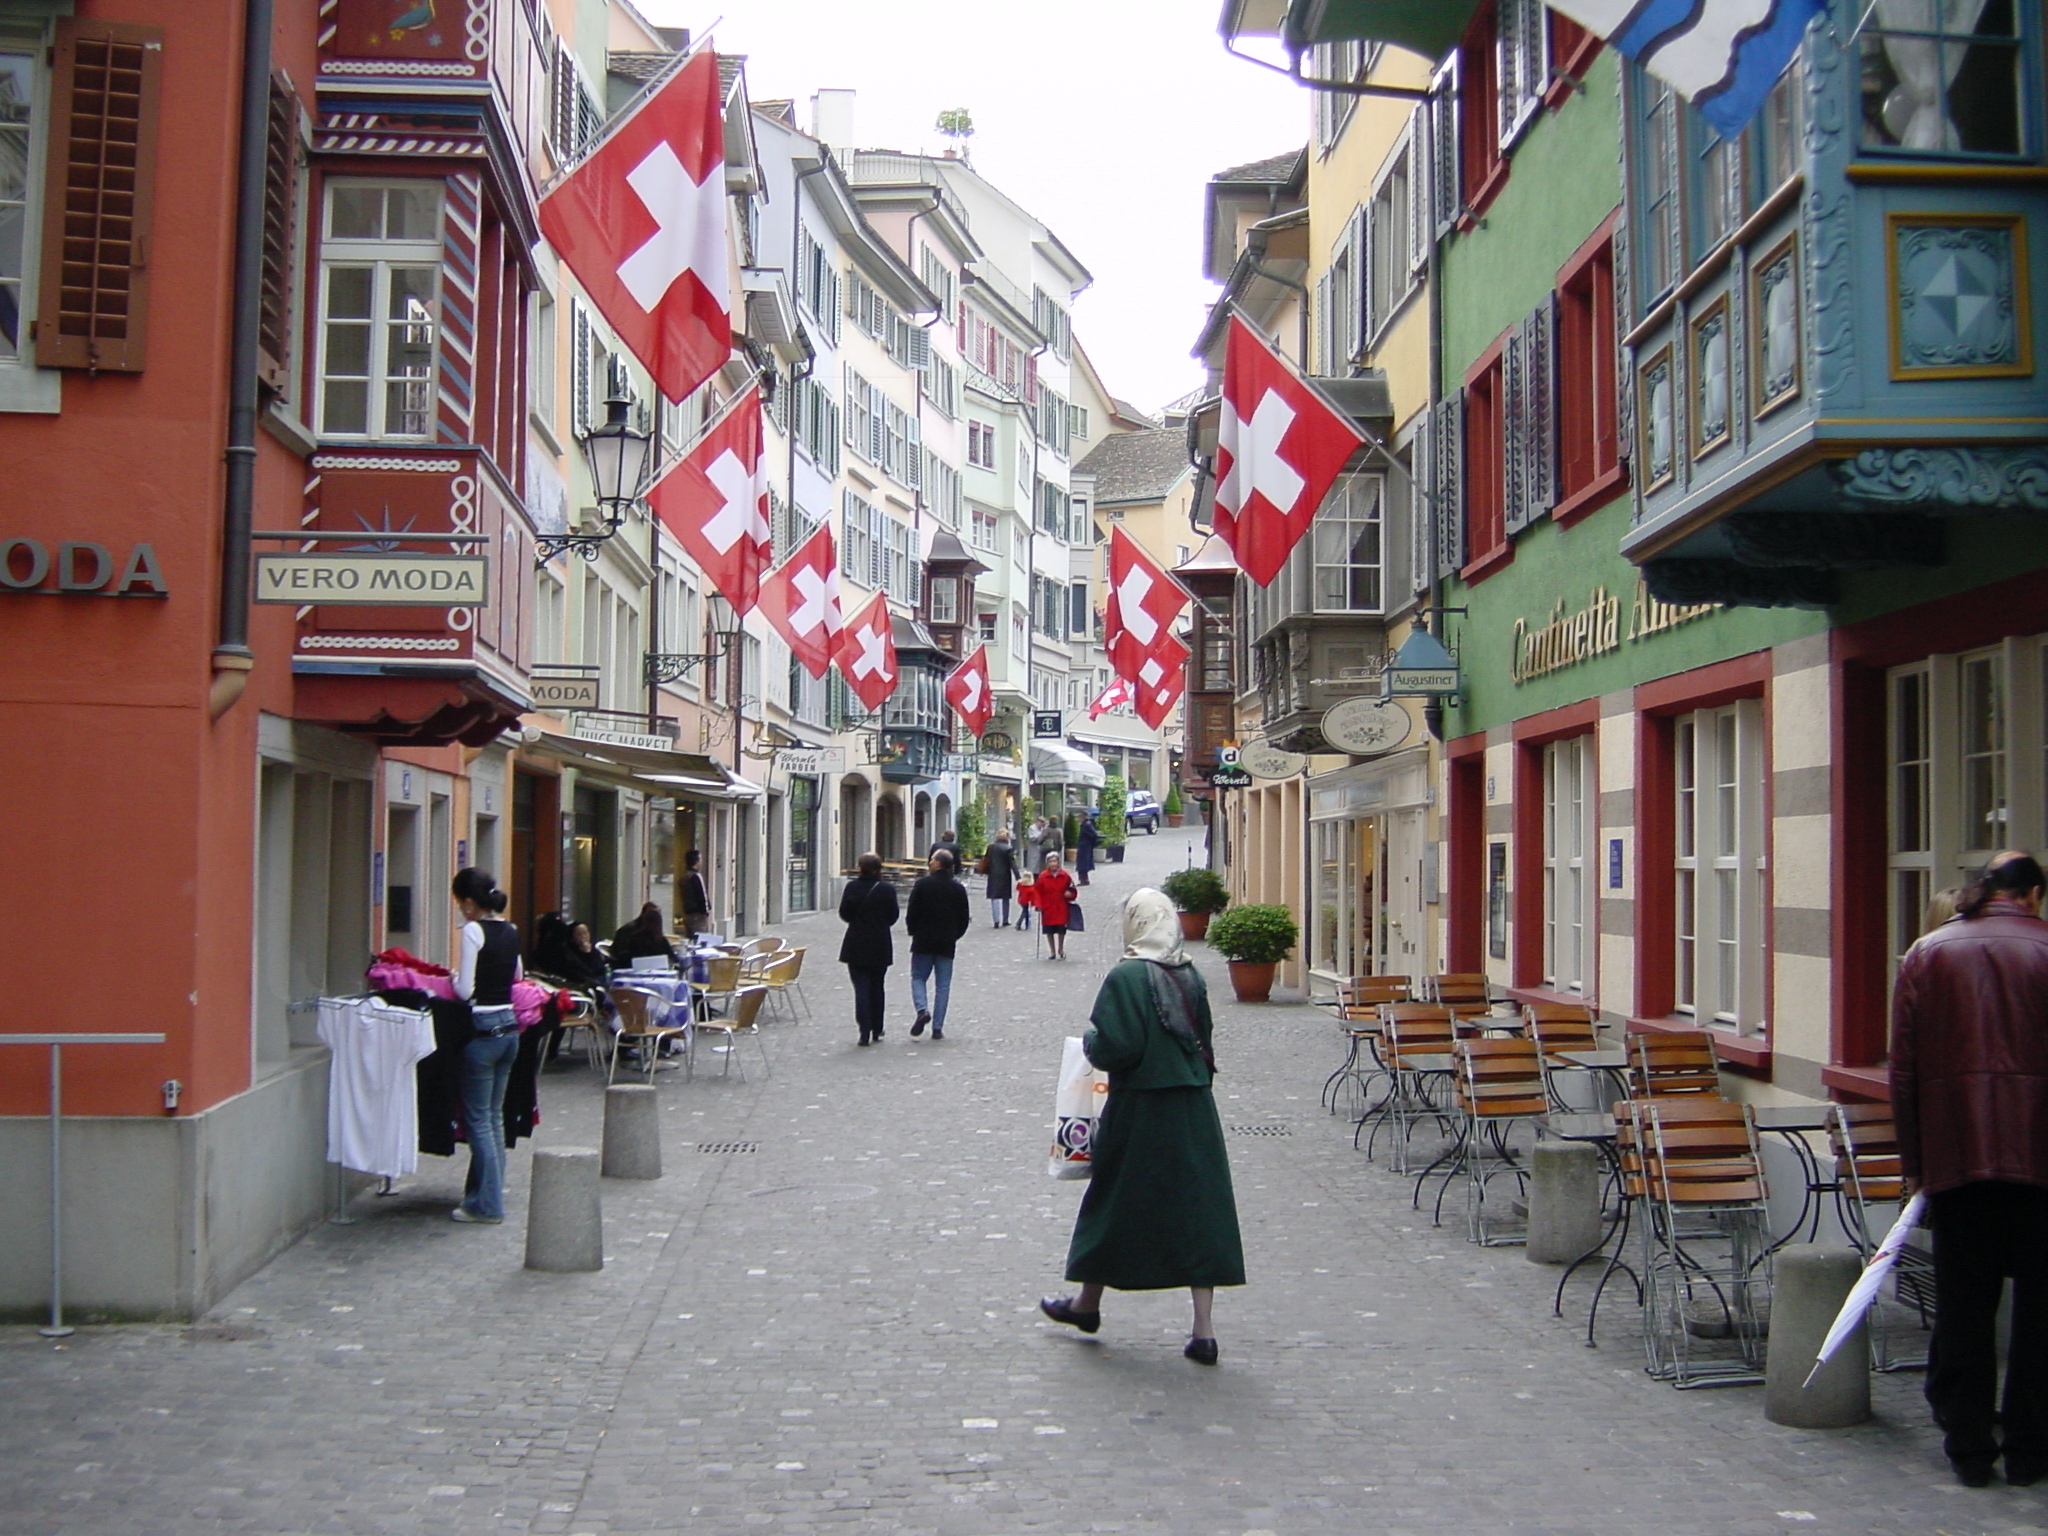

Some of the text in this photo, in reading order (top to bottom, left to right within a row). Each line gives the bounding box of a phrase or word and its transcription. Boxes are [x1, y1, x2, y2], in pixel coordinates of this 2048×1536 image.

[267, 568, 475, 591] VERO MODA
[1511, 584, 1619, 684] Cantinetta
[1394, 674, 1453, 689] Augustiner
[530, 686, 591, 700] MODA
